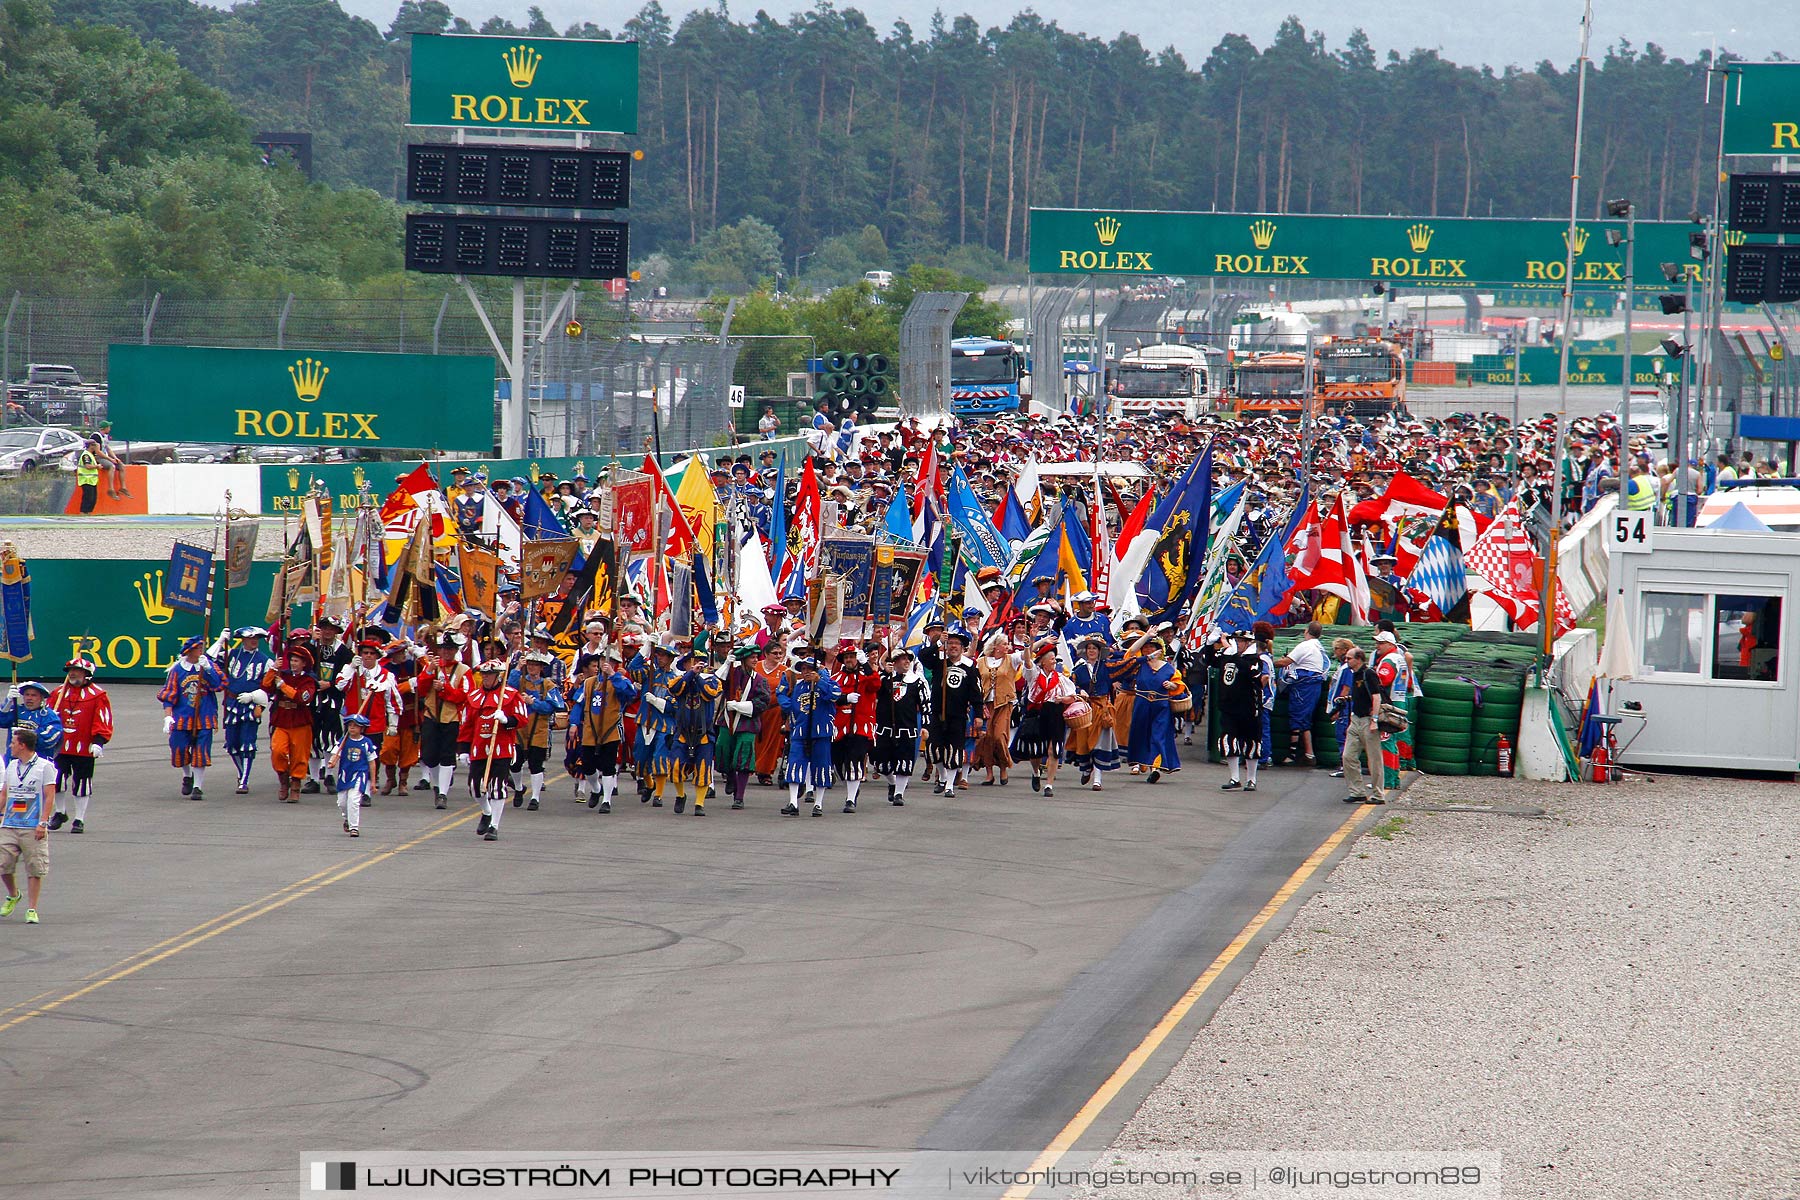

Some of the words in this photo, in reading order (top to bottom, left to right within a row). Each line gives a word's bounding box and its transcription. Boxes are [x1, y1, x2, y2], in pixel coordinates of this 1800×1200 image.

[451, 94, 590, 126] ROLEX
[1059, 251, 1153, 273] ROLEX
[1215, 254, 1309, 275] ROLEX
[1371, 258, 1468, 279] ROLEX
[1526, 260, 1622, 281] ROLEX
[731, 390, 743, 403] 46
[235, 409, 380, 441] ROLEX
[1616, 517, 1646, 544] 54
